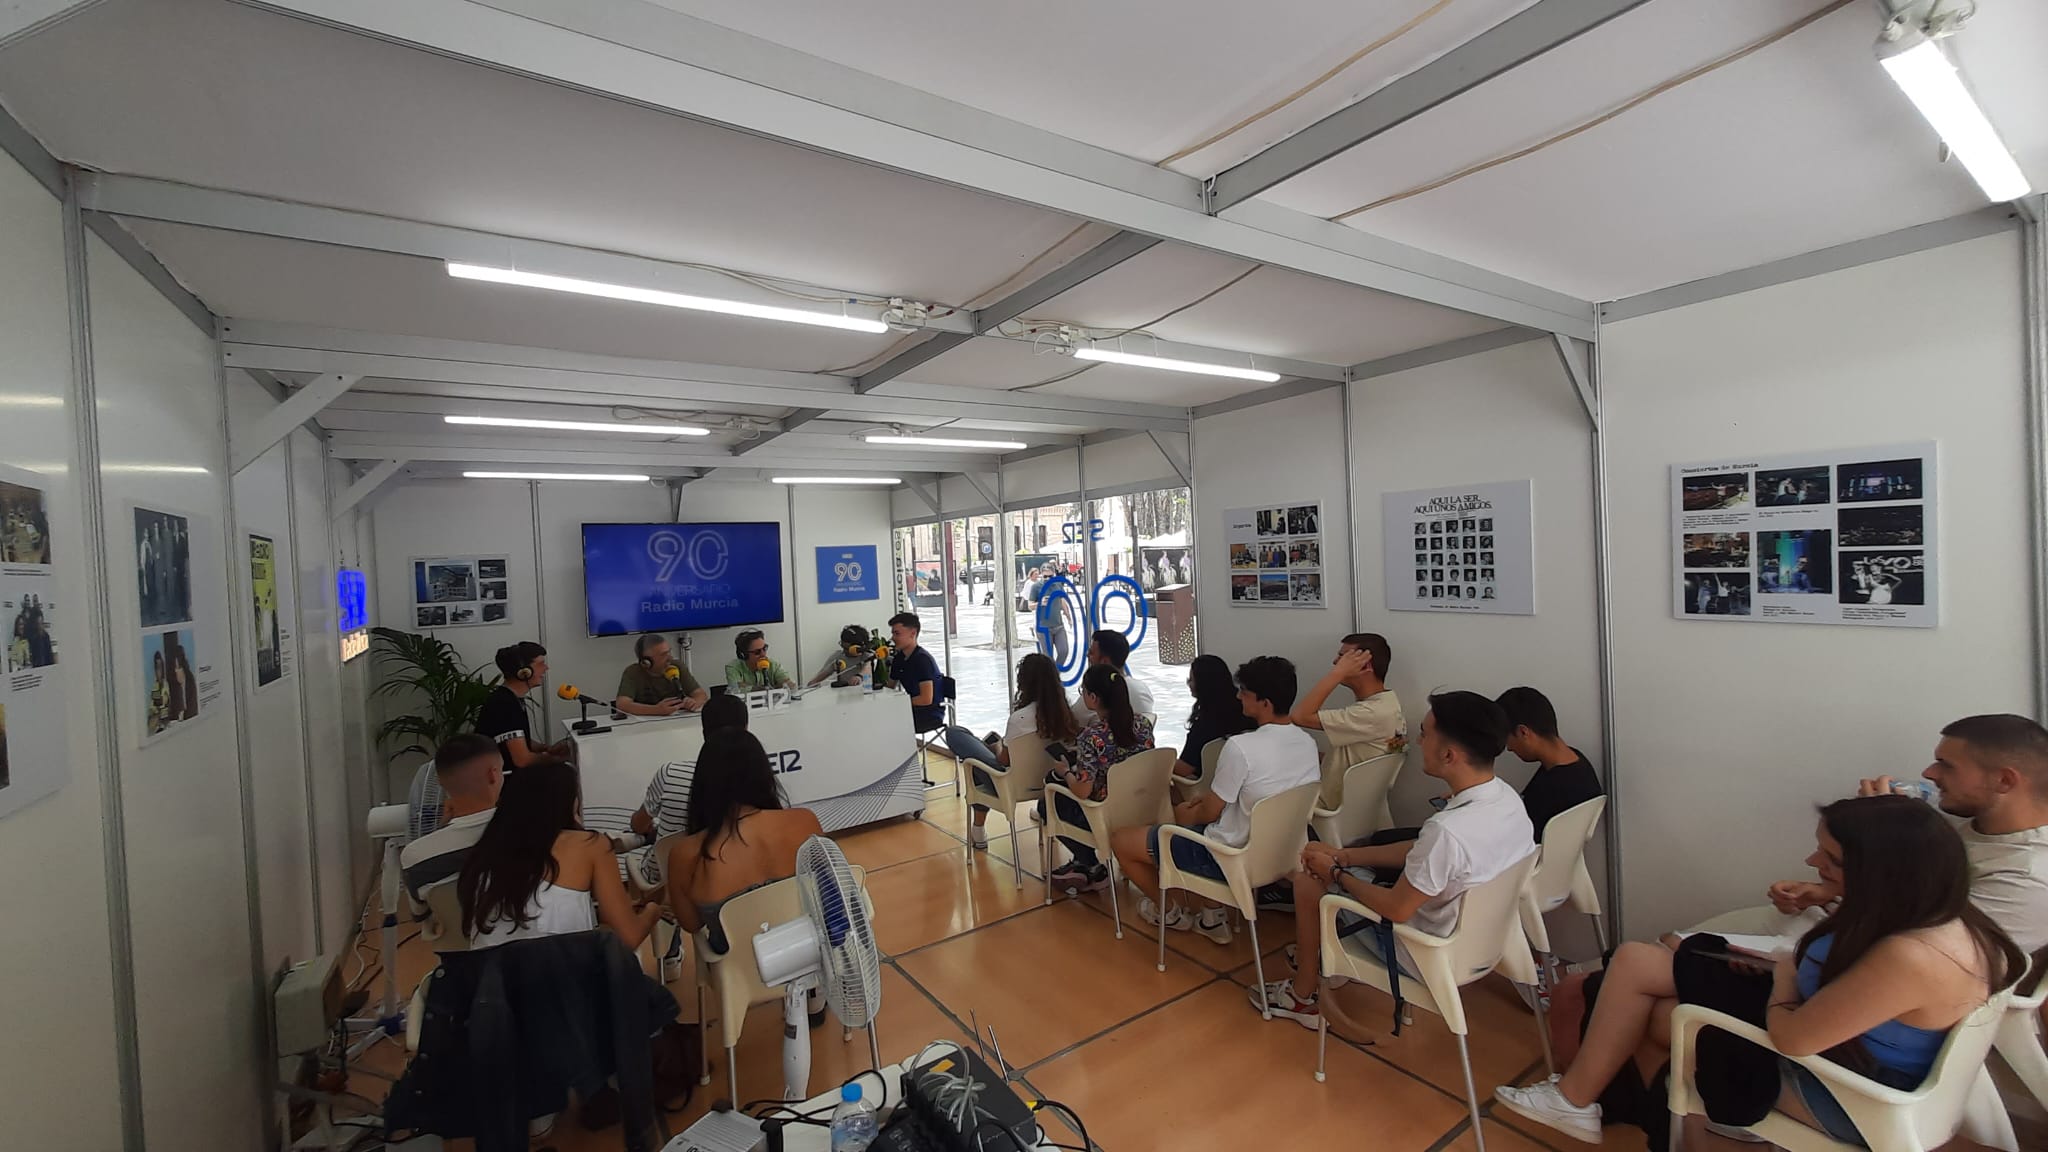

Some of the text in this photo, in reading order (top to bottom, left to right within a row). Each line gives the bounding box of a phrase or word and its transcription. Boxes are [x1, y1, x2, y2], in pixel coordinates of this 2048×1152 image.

[647, 529, 728, 581] 90
[834, 562, 862, 582] 90
[641, 598, 739, 613] Radio Murcia
[734, 688, 790, 711] ER
[767, 750, 802, 774] ER
